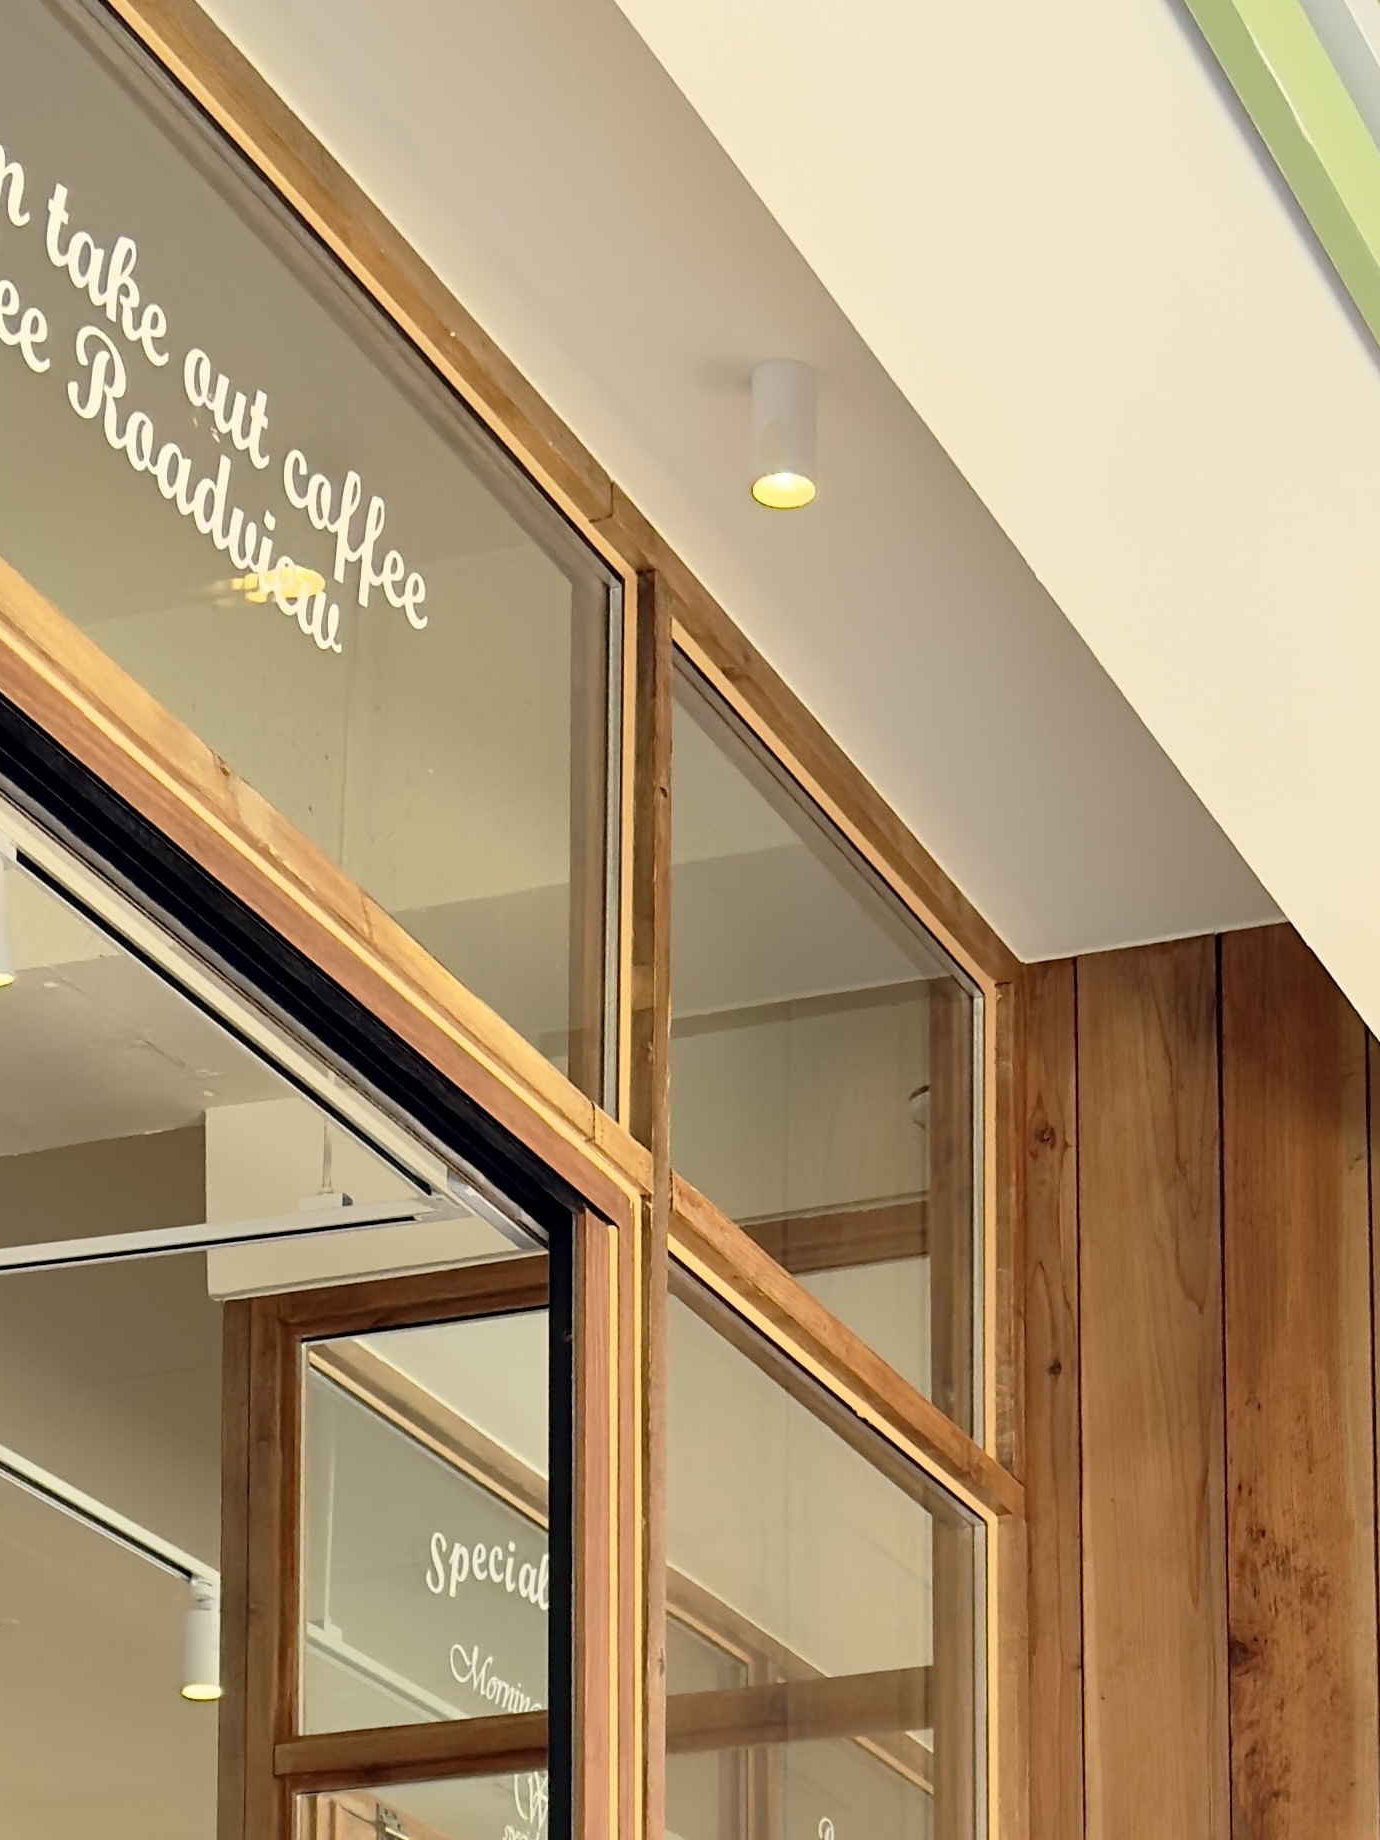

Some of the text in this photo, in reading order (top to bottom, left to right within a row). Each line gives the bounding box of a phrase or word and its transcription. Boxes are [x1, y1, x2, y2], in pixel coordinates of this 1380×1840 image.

[46, 184, 169, 366] take
[184, 348, 270, 469] out
[283, 449, 428, 629] coffee
[67, 325, 343, 653] Roadview
[426, 1532, 549, 1611] Special
